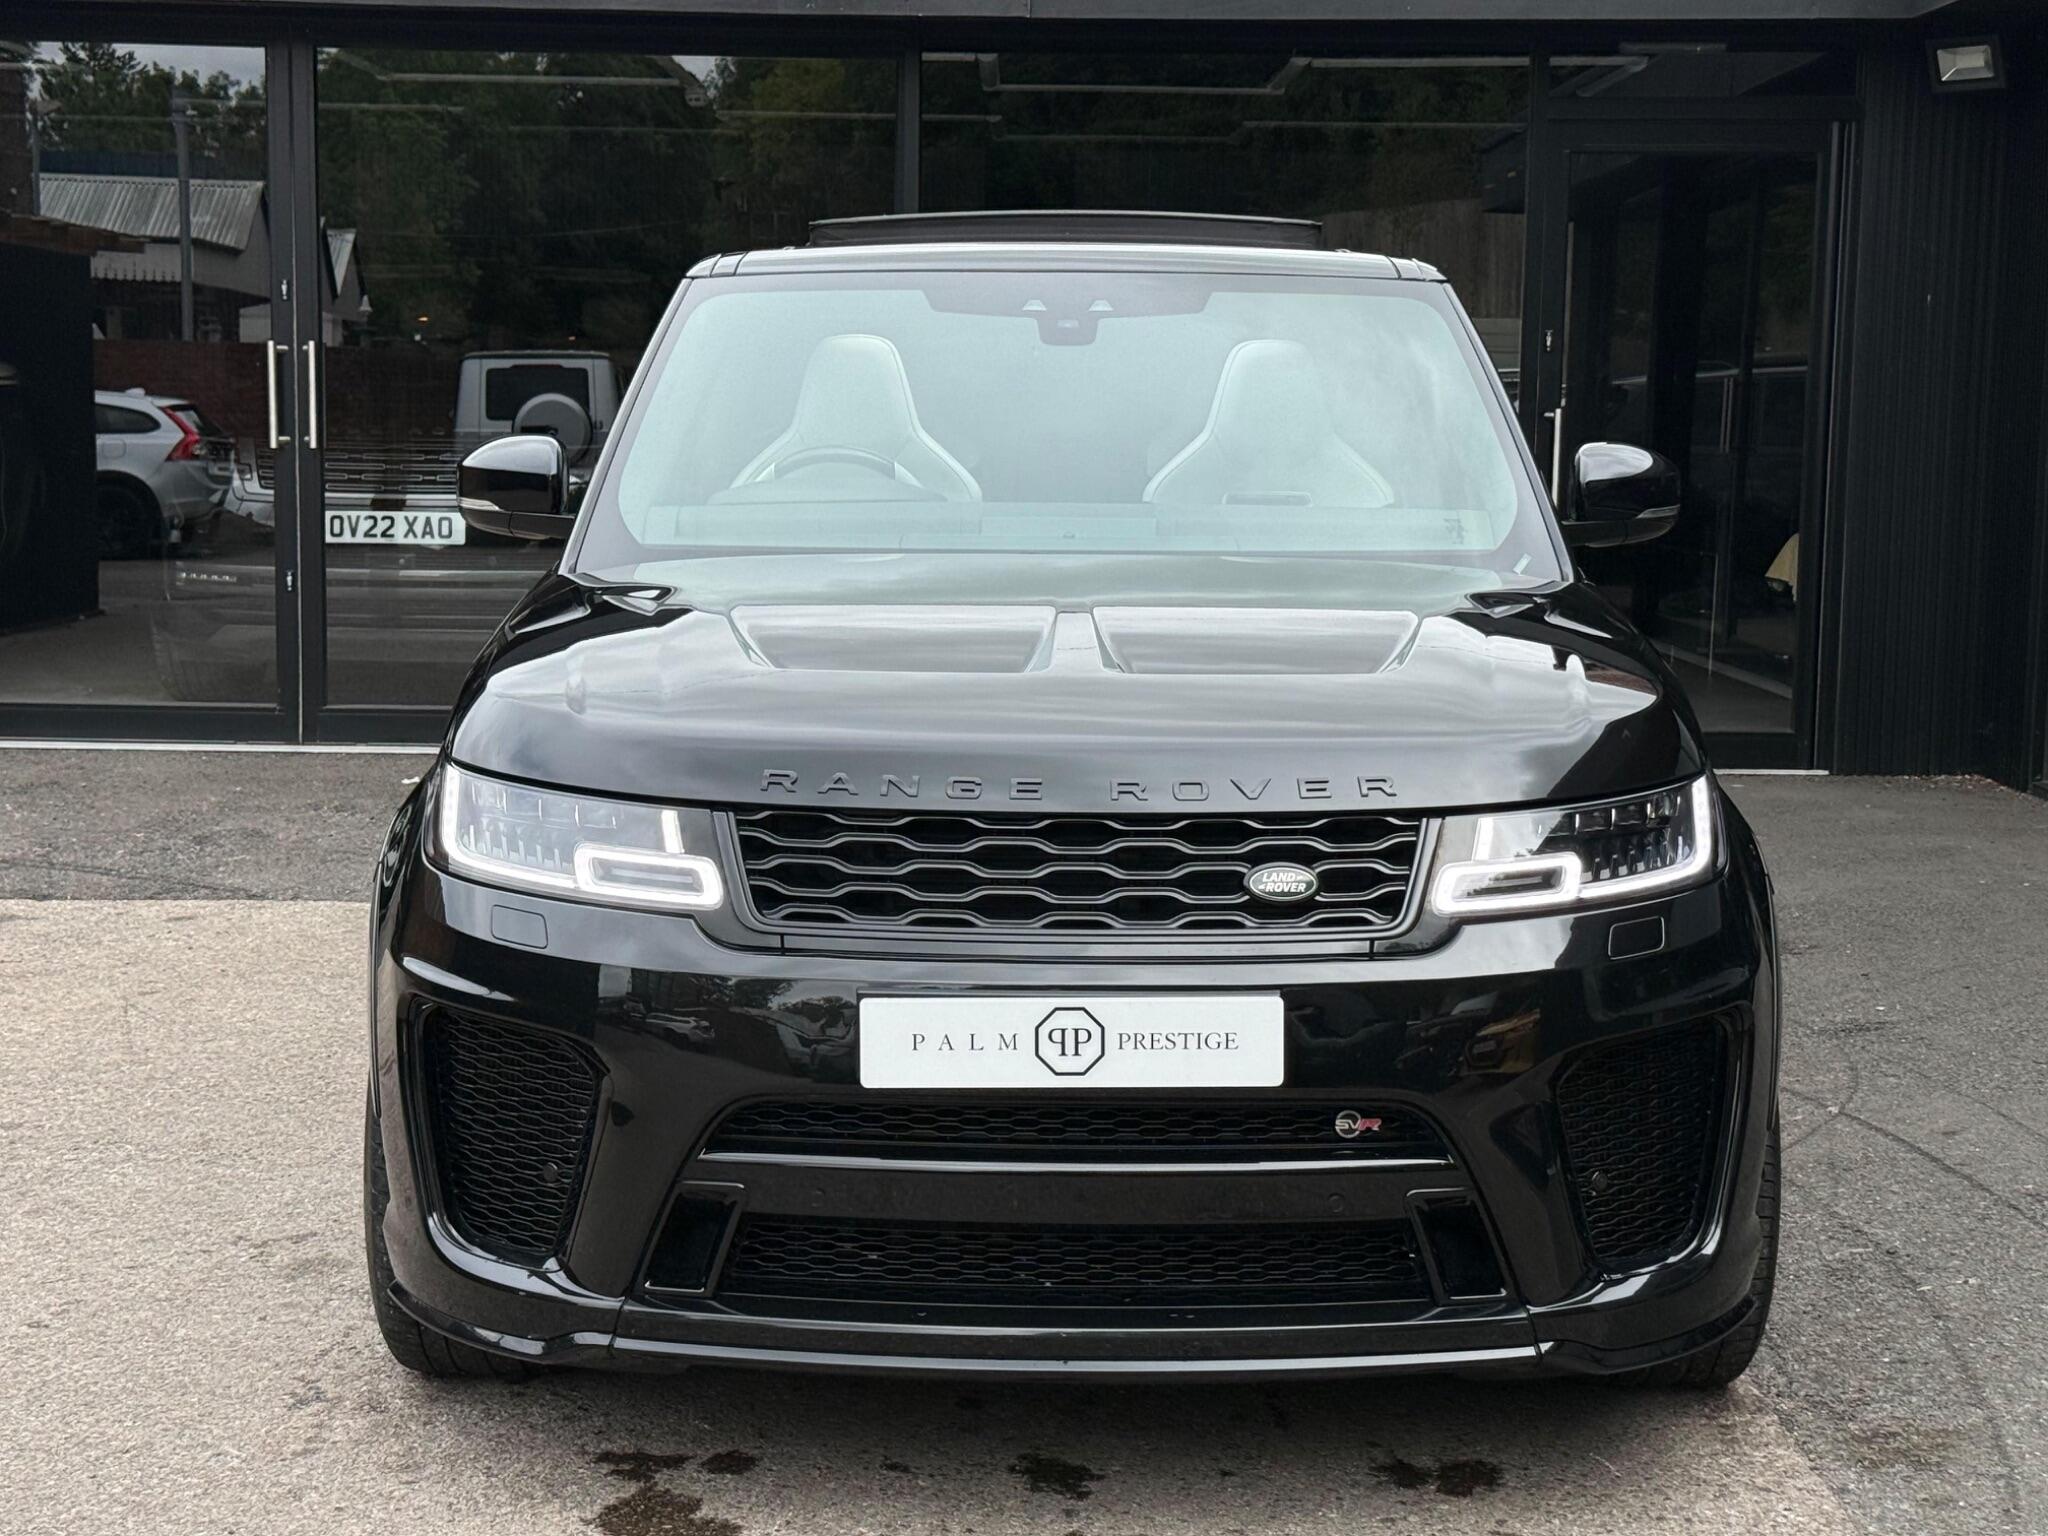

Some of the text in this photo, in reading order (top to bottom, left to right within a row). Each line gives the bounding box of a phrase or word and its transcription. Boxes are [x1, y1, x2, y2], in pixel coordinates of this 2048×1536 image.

[329, 514, 453, 539] OV22 XAO
[760, 769, 1397, 801] RANGE ROVER
[1262, 872, 1296, 883] LAND
[1265, 882, 1307, 893] ROVER
[911, 1033, 1019, 1051] PALM
[1117, 1032, 1239, 1051] PRESTIGE
[1335, 1116, 1382, 1132] SVR
